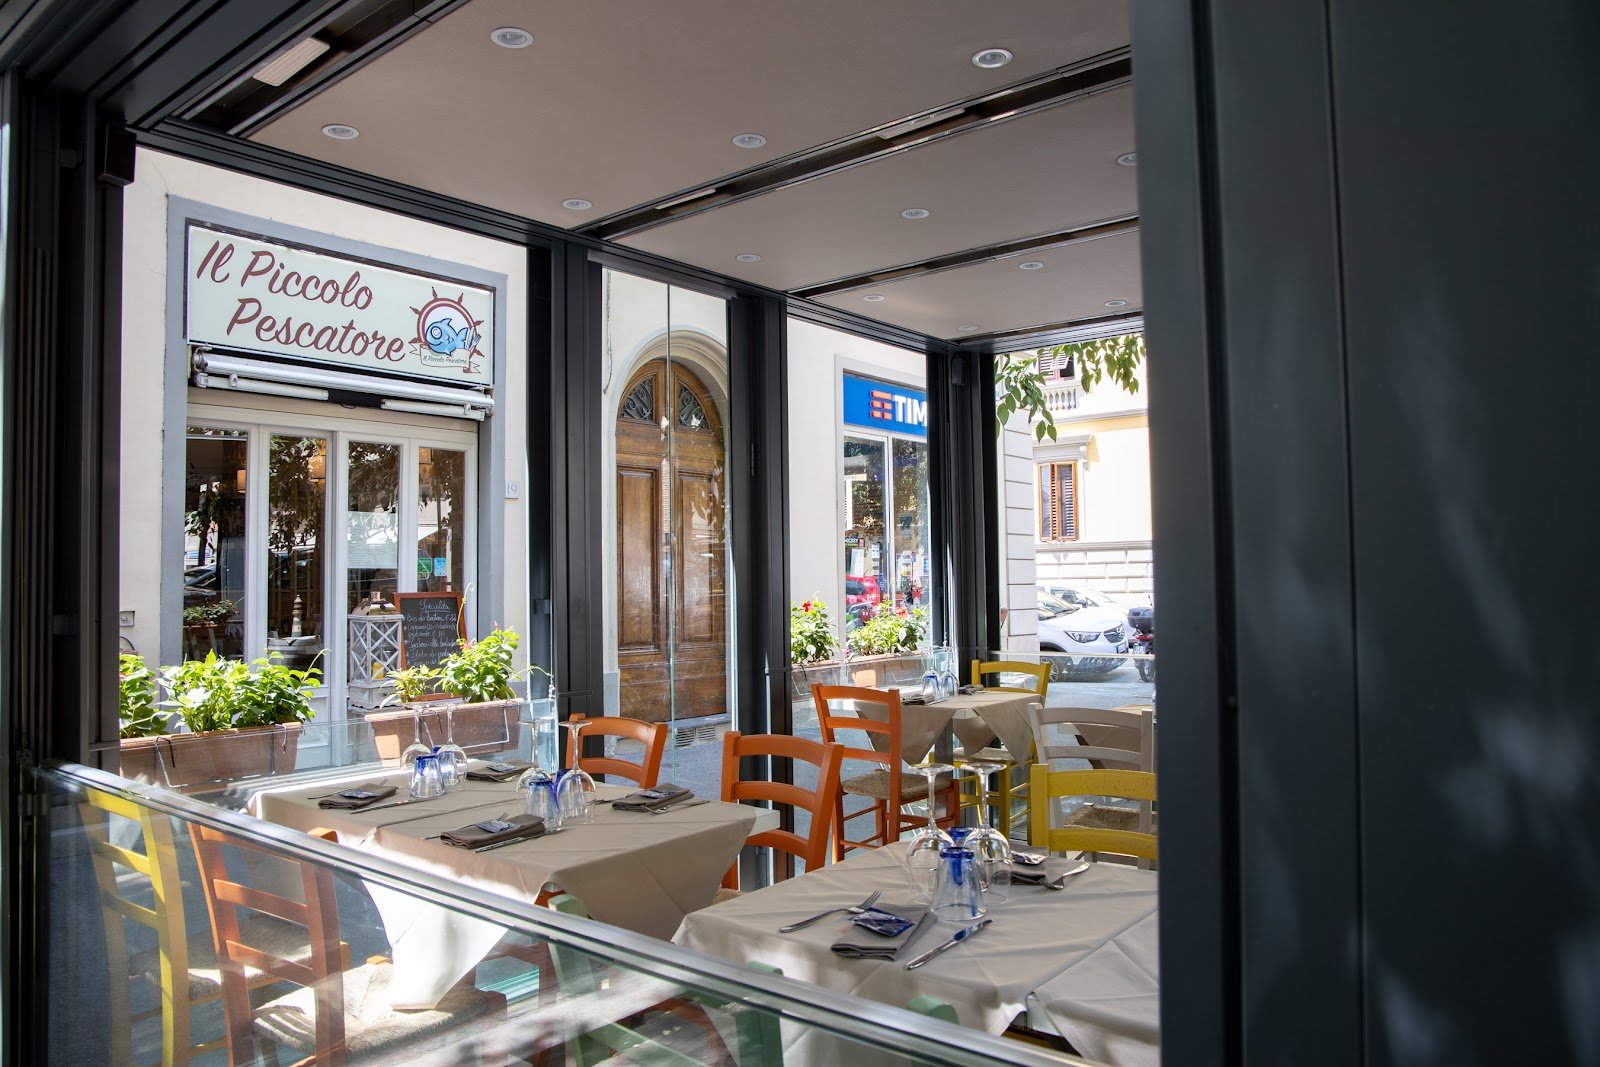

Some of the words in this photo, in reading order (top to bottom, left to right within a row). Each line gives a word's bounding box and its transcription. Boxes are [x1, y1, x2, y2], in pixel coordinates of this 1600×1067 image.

[196, 240, 235, 283] Il
[240, 250, 374, 310] Piccolo
[226, 297, 407, 362] Pescatore
[892, 394, 927, 427] TIM
